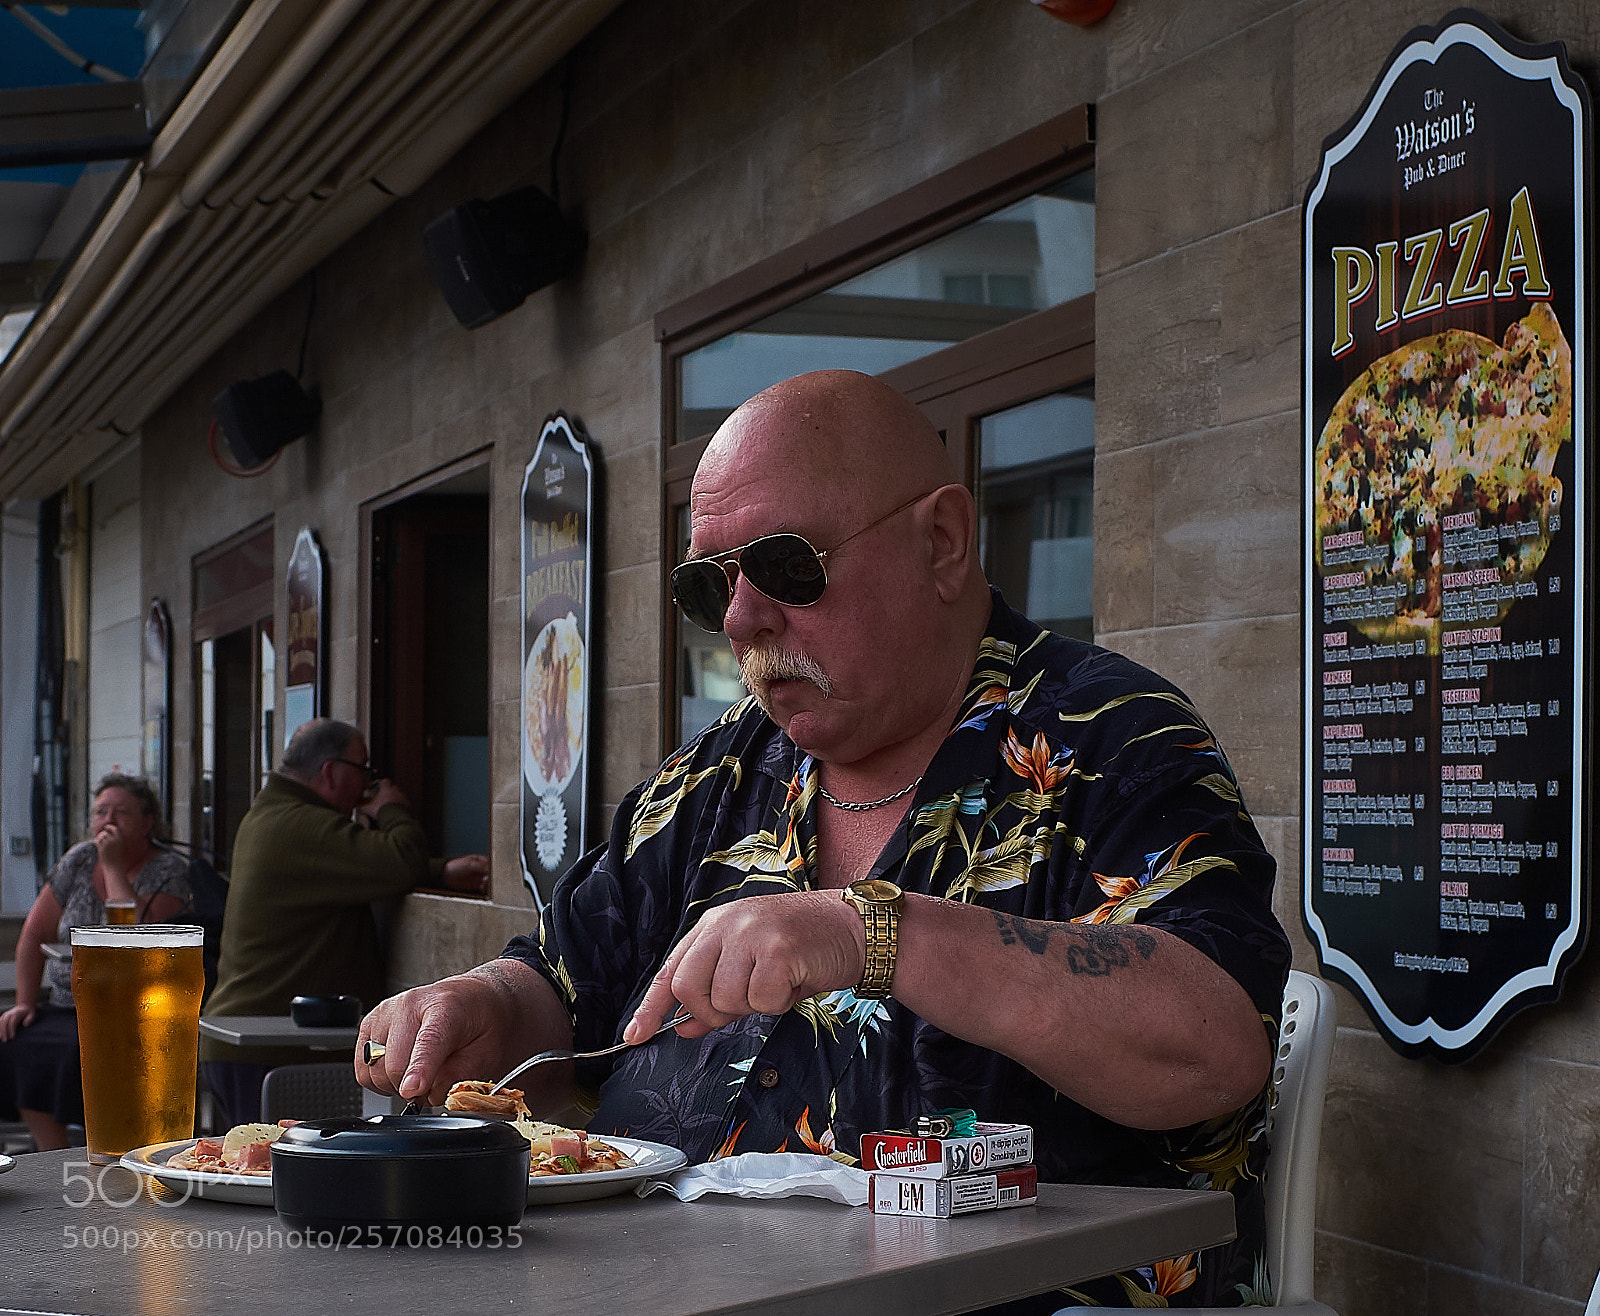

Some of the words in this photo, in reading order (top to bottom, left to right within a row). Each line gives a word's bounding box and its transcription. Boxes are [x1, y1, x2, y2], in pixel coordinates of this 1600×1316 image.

[1424, 88, 1445, 111] The
[1394, 99, 1477, 162] Watson's
[1403, 166, 1425, 191] Pub
[1426, 158, 1436, 178] &
[1437, 150, 1467, 176] Diner
[1331, 186, 1554, 360] PIZZA
[1441, 630, 1471, 647] QUATTRO
[874, 1140, 927, 1172] Chesterfield
[898, 1181, 925, 1212] L&M
